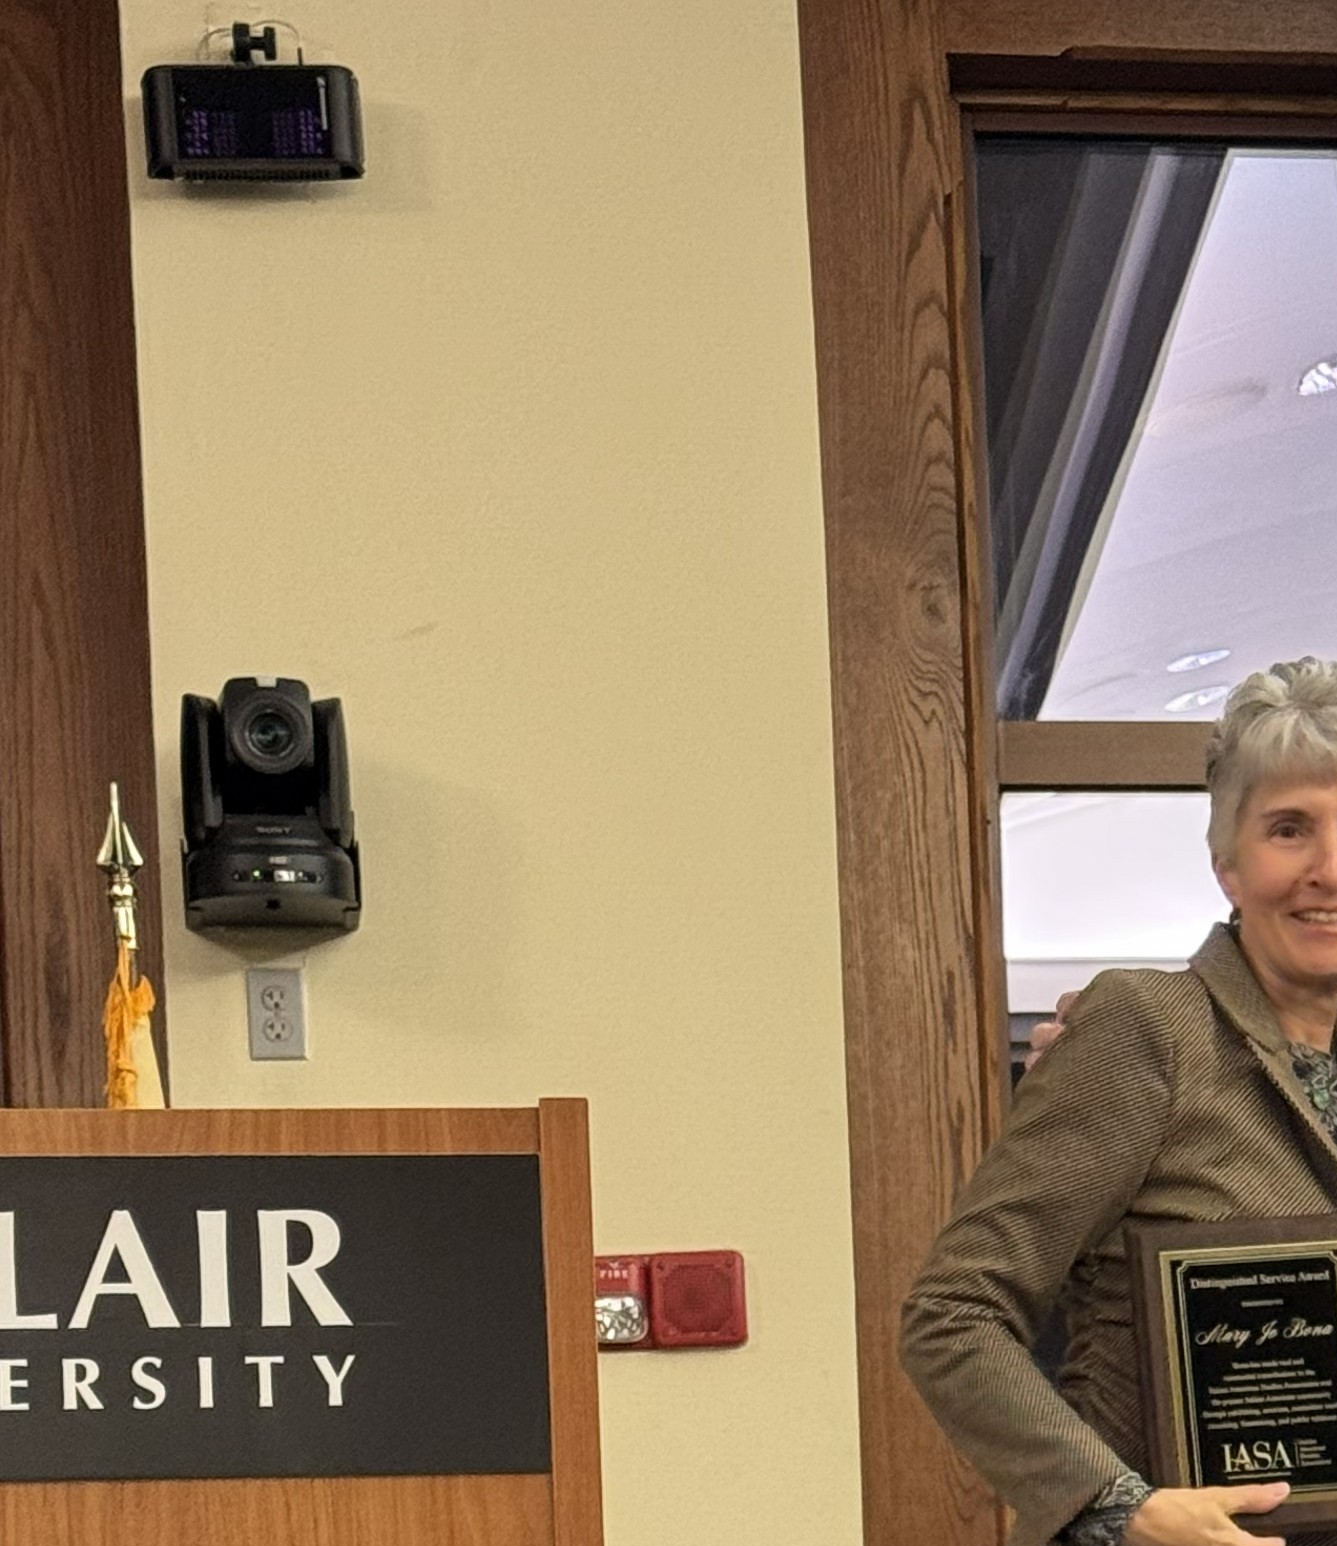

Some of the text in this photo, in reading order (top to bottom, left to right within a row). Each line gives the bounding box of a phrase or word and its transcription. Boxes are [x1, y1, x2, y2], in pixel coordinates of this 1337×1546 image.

[0, 1209, 354, 1330] LAIR
[1260, 1273, 1296, 1284] Service
[1195, 1323, 1251, 1349] Mary
[1255, 1320, 1278, 1345] Jo
[0, 1355, 355, 1411] ERSITY
[1220, 1440, 1295, 1474] IASA
